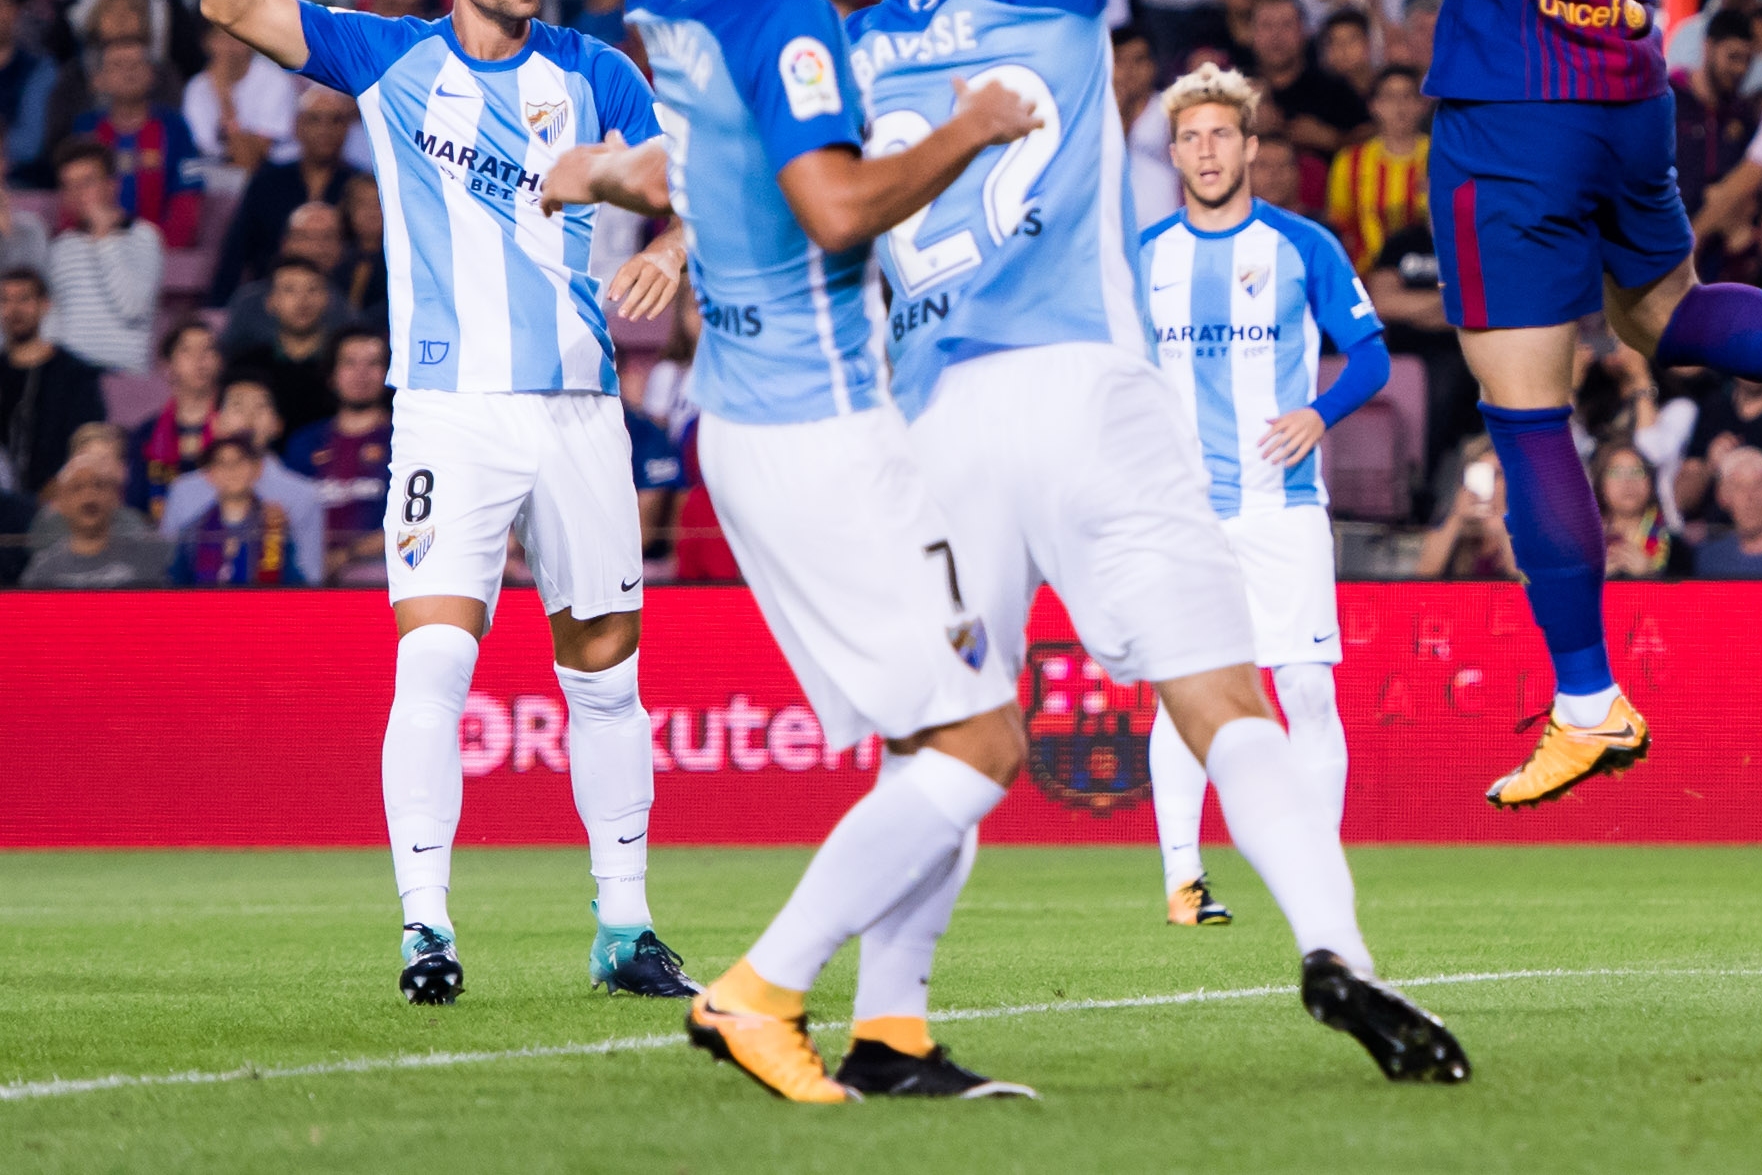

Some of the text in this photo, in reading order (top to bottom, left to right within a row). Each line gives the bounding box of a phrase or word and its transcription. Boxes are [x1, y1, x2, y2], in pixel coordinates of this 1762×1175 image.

[414, 129, 546, 193] MARATH
[471, 178, 513, 201] BET
[402, 469, 435, 525] 8
[921, 537, 966, 614] 7
